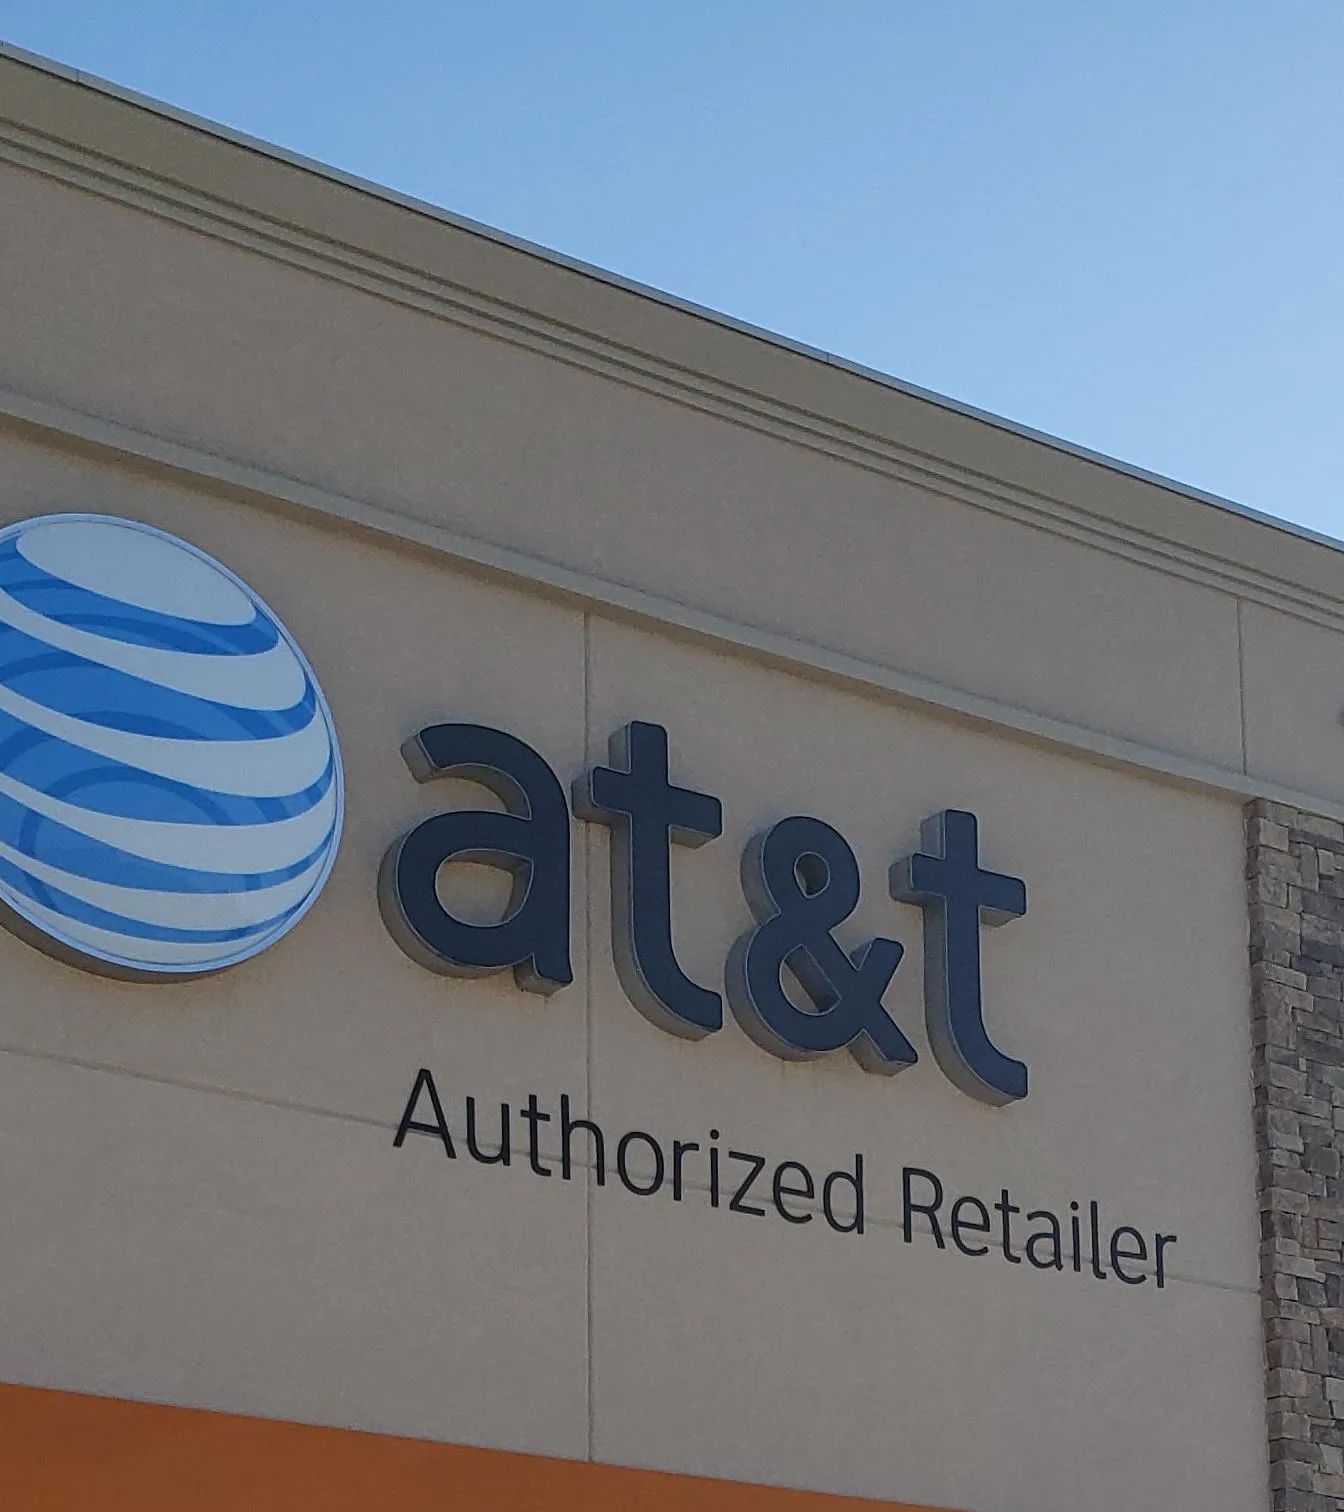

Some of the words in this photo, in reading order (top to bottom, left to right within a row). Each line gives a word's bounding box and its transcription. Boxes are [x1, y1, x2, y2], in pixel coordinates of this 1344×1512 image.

[378, 720, 1029, 1108] at&t
[392, 1067, 865, 1236] Authorized
[903, 1166, 1178, 1290] Retailer
